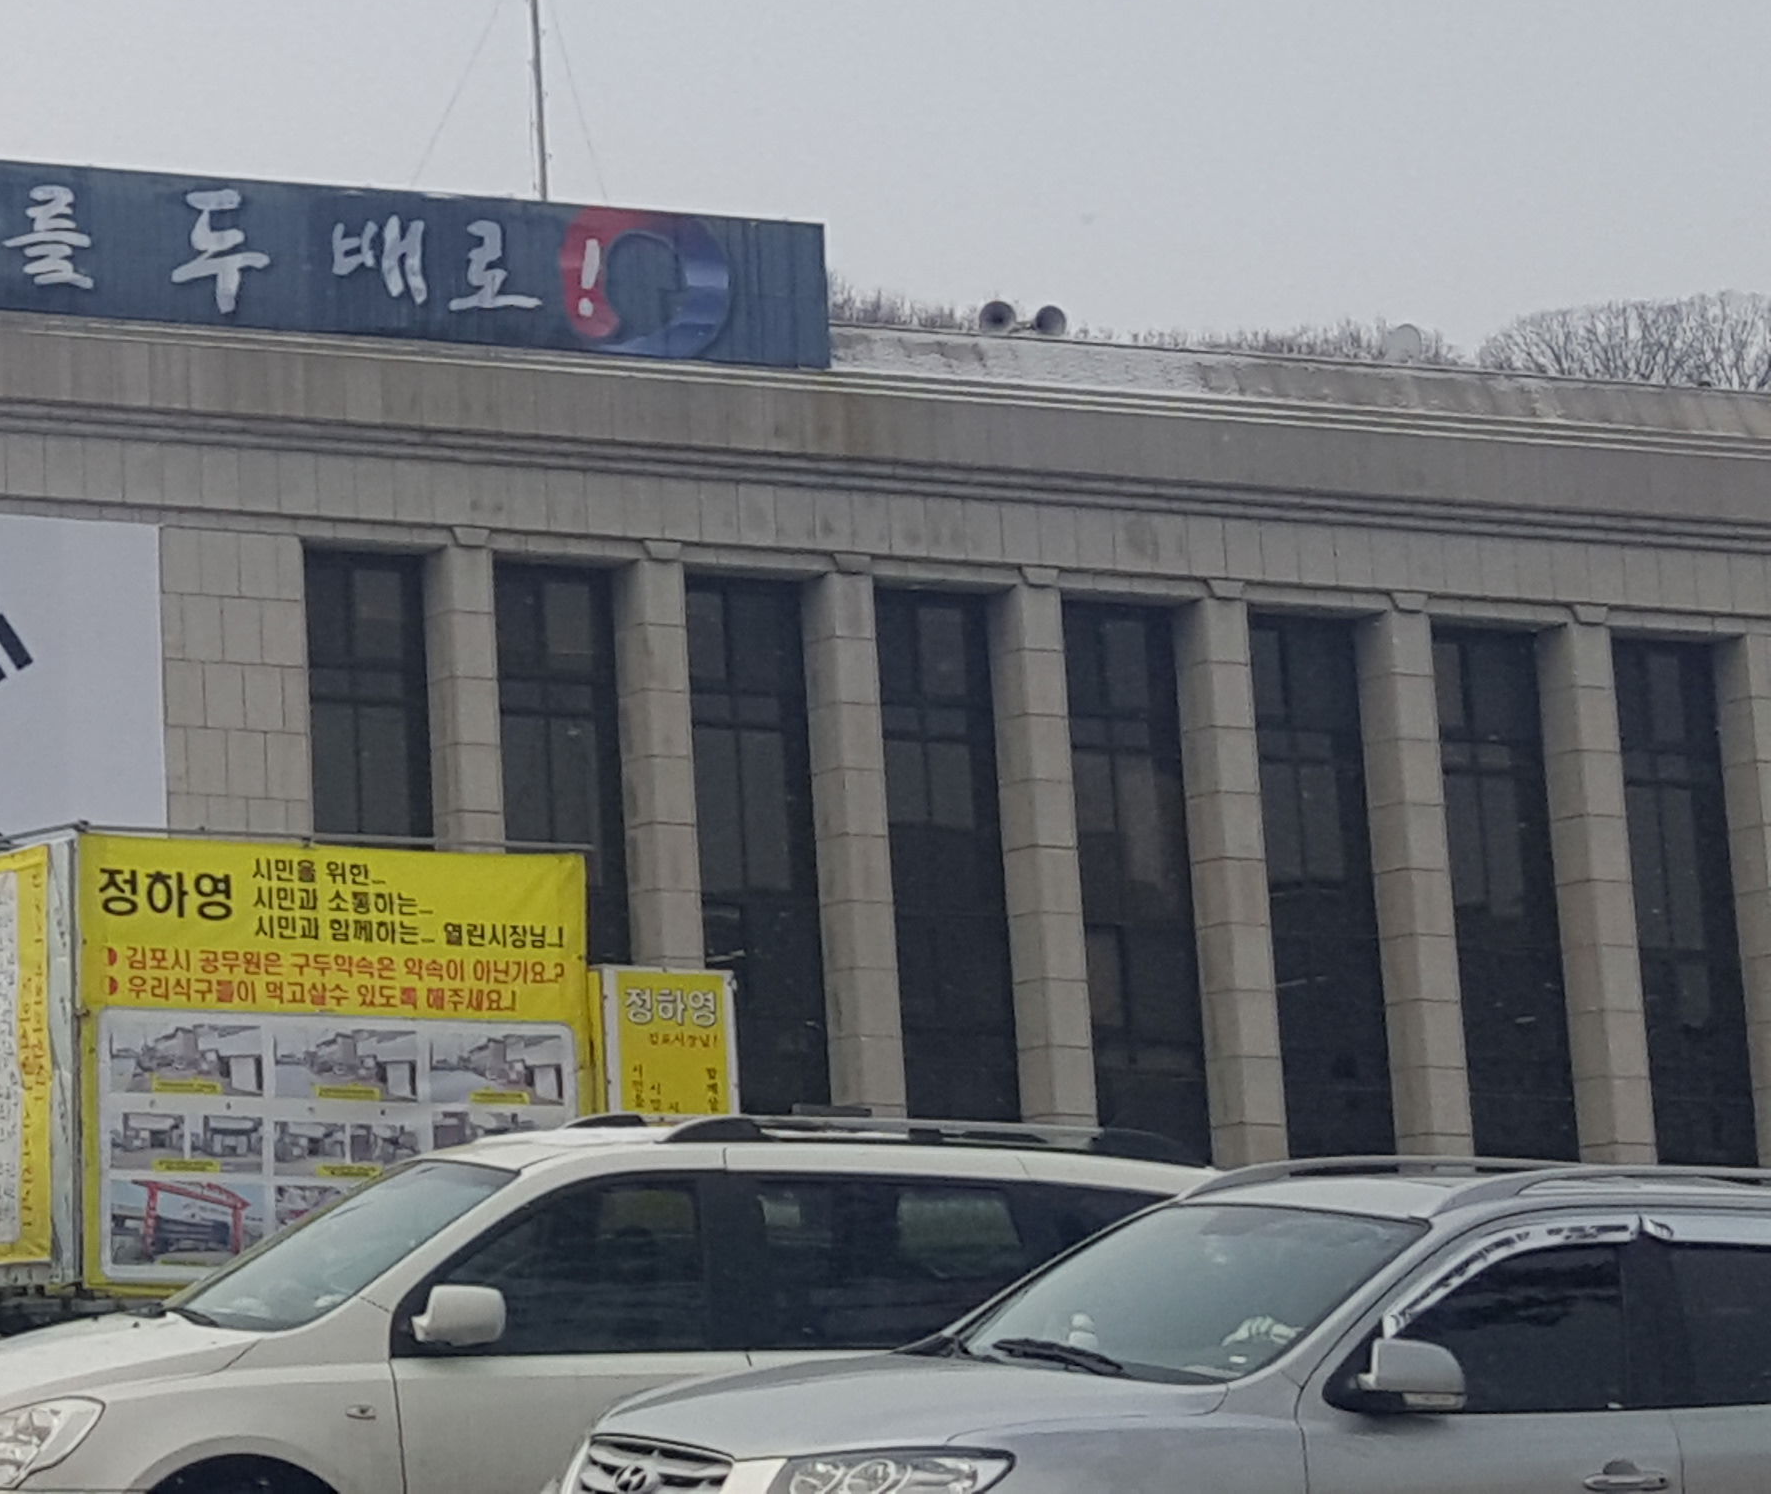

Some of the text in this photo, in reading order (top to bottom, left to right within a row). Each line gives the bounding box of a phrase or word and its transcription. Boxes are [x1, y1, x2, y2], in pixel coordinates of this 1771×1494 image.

[252, 857, 316, 883] 시민을
[98, 867, 233, 921] 정하영
[253, 885, 318, 911] 시민과
[254, 915, 319, 940] 시민과
[126, 946, 192, 972] 김포시
[199, 949, 283, 976] 공무원은
[291, 952, 397, 981] 구두약속은
[404, 958, 465, 983] 약속이
[128, 976, 257, 1004] 우리식구들이
[358, 984, 419, 1010] 있도록
[624, 987, 718, 1028] 정하영
